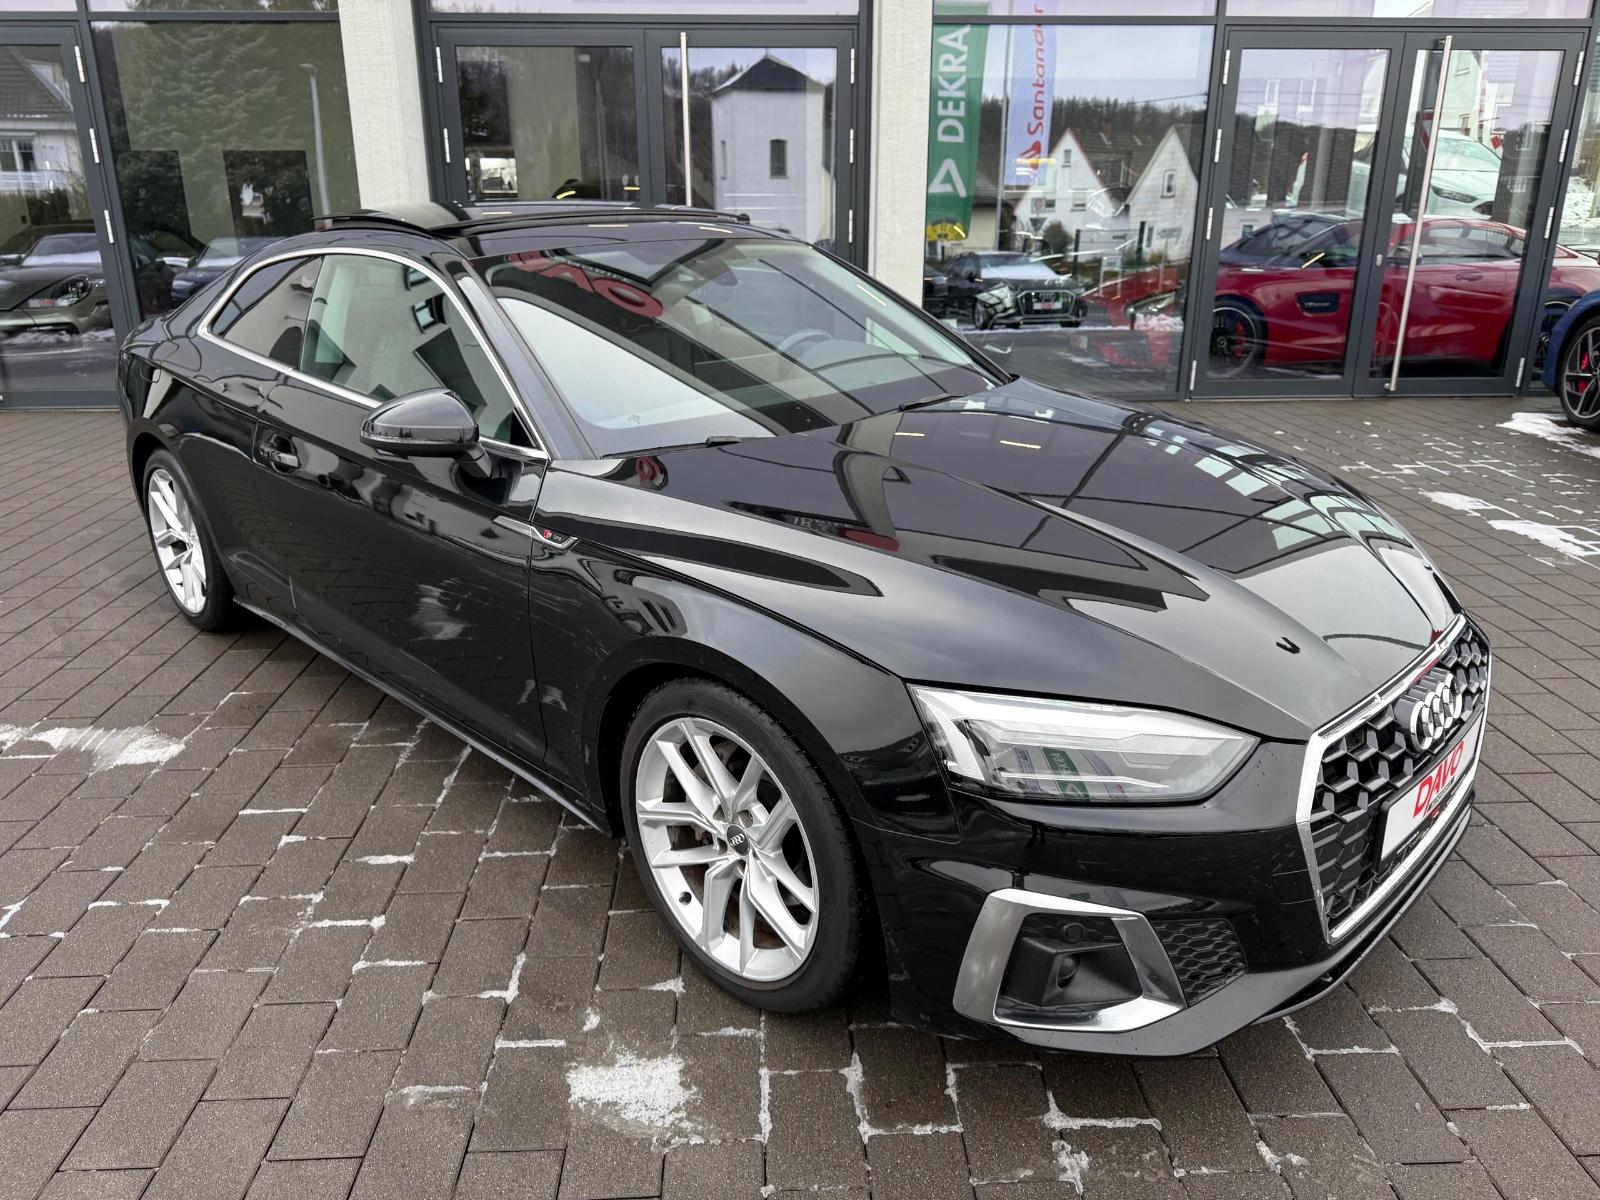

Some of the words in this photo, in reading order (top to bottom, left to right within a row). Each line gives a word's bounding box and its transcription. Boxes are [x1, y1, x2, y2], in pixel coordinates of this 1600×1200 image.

[936, 24, 971, 143] DEKRA
[1027, 3, 1046, 136] Santandr
[1413, 740, 1465, 817] DAVO
